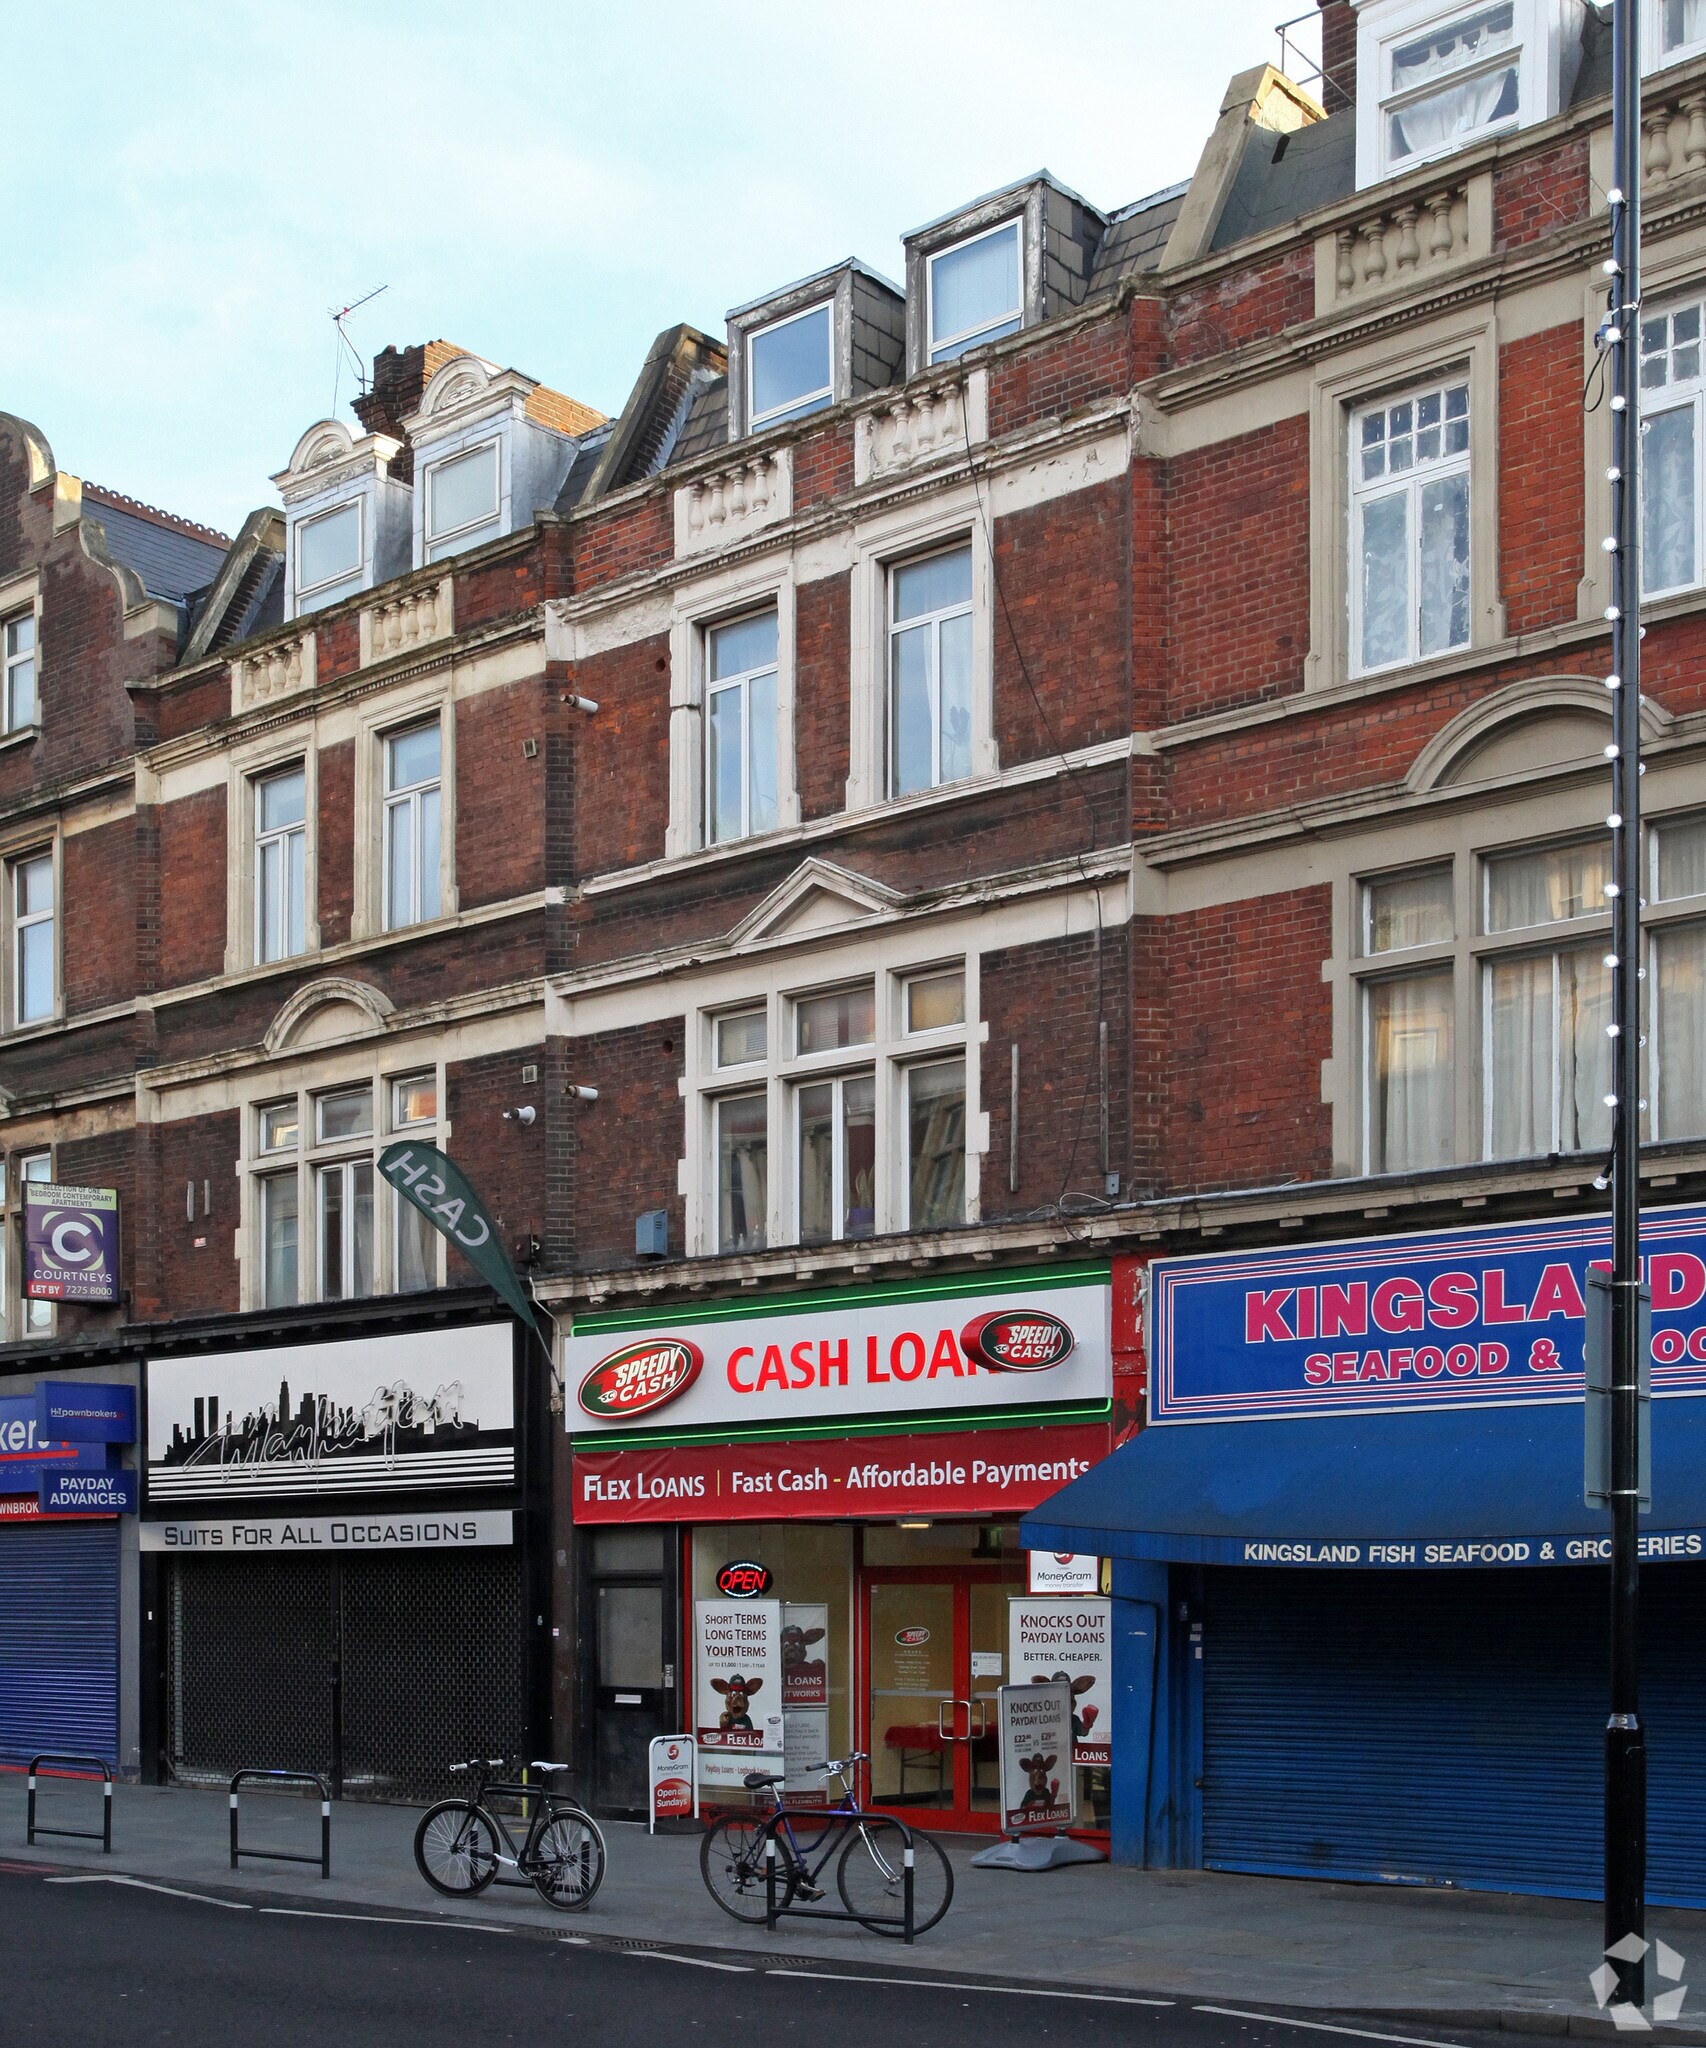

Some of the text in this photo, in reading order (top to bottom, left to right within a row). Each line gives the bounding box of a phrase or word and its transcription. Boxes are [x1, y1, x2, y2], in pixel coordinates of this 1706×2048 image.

[51, 1198, 92, 1208] APARTMENTS
[62, 1192, 112, 1202] CONTEMPORARY
[51, 1221, 92, 1262] C
[33, 1269, 112, 1283] COURTNEYS
[31, 1284, 112, 1296] LET BY 7275 8000
[1246, 1252, 1706, 1344] KINGSLAD
[1006, 1325, 1062, 1345] SPEEDY
[1010, 1344, 1056, 1359] CASH
[612, 1347, 682, 1388] SPEEDY
[726, 1338, 849, 1394] CASH
[1304, 1341, 1510, 1386] SEAFOOD
[1528, 1337, 1562, 1372] &
[619, 1371, 677, 1402] CASH
[60, 1478, 114, 1490] PAYDAY
[583, 1474, 631, 1501] FLEX
[637, 1472, 705, 1499] LOANS
[731, 1471, 773, 1494] Fast
[777, 1467, 828, 1492] Cash
[846, 1460, 966, 1489] Affordable
[972, 1457, 1091, 1490] Payments
[50, 1492, 127, 1505] ADVANCES
[164, 1521, 477, 1546] SUITS FOR ALL OCCASIONS
[1244, 1534, 1702, 1563] KINGSLAND FISH SEAFOOD & GROERIES
[719, 1571, 767, 1590] OPEN
[1037, 1571, 1092, 1582] MoneyGram
[705, 1613, 767, 1625] SHORT TERMS
[1020, 1614, 1105, 1628] KNOCKS OUT
[705, 1628, 767, 1641] LONG TERMS
[1021, 1631, 1105, 1643] PAYDAY LOANS
[705, 1645, 767, 1658] YOUR TERMS
[1023, 1652, 1102, 1662] BETTER. CHEAPER.
[787, 1675, 822, 1686] LOANS
[792, 1690, 821, 1698] WORKS
[1010, 1699, 1061, 1714] KNOCKS OUT
[1010, 1713, 1061, 1727] PAYDAY LOANS
[727, 1734, 746, 1745] FLEX
[1075, 1748, 1108, 1761] LOANS
[657, 1764, 689, 1772] MoneyGram
[705, 1764, 720, 1774] Payday
[721, 1765, 734, 1774] Loans
[657, 1789, 677, 1798] Open
[657, 1798, 687, 1808] Sundays
[1029, 1810, 1045, 1822] FLEX
[1047, 1807, 1068, 1820] LOANS
